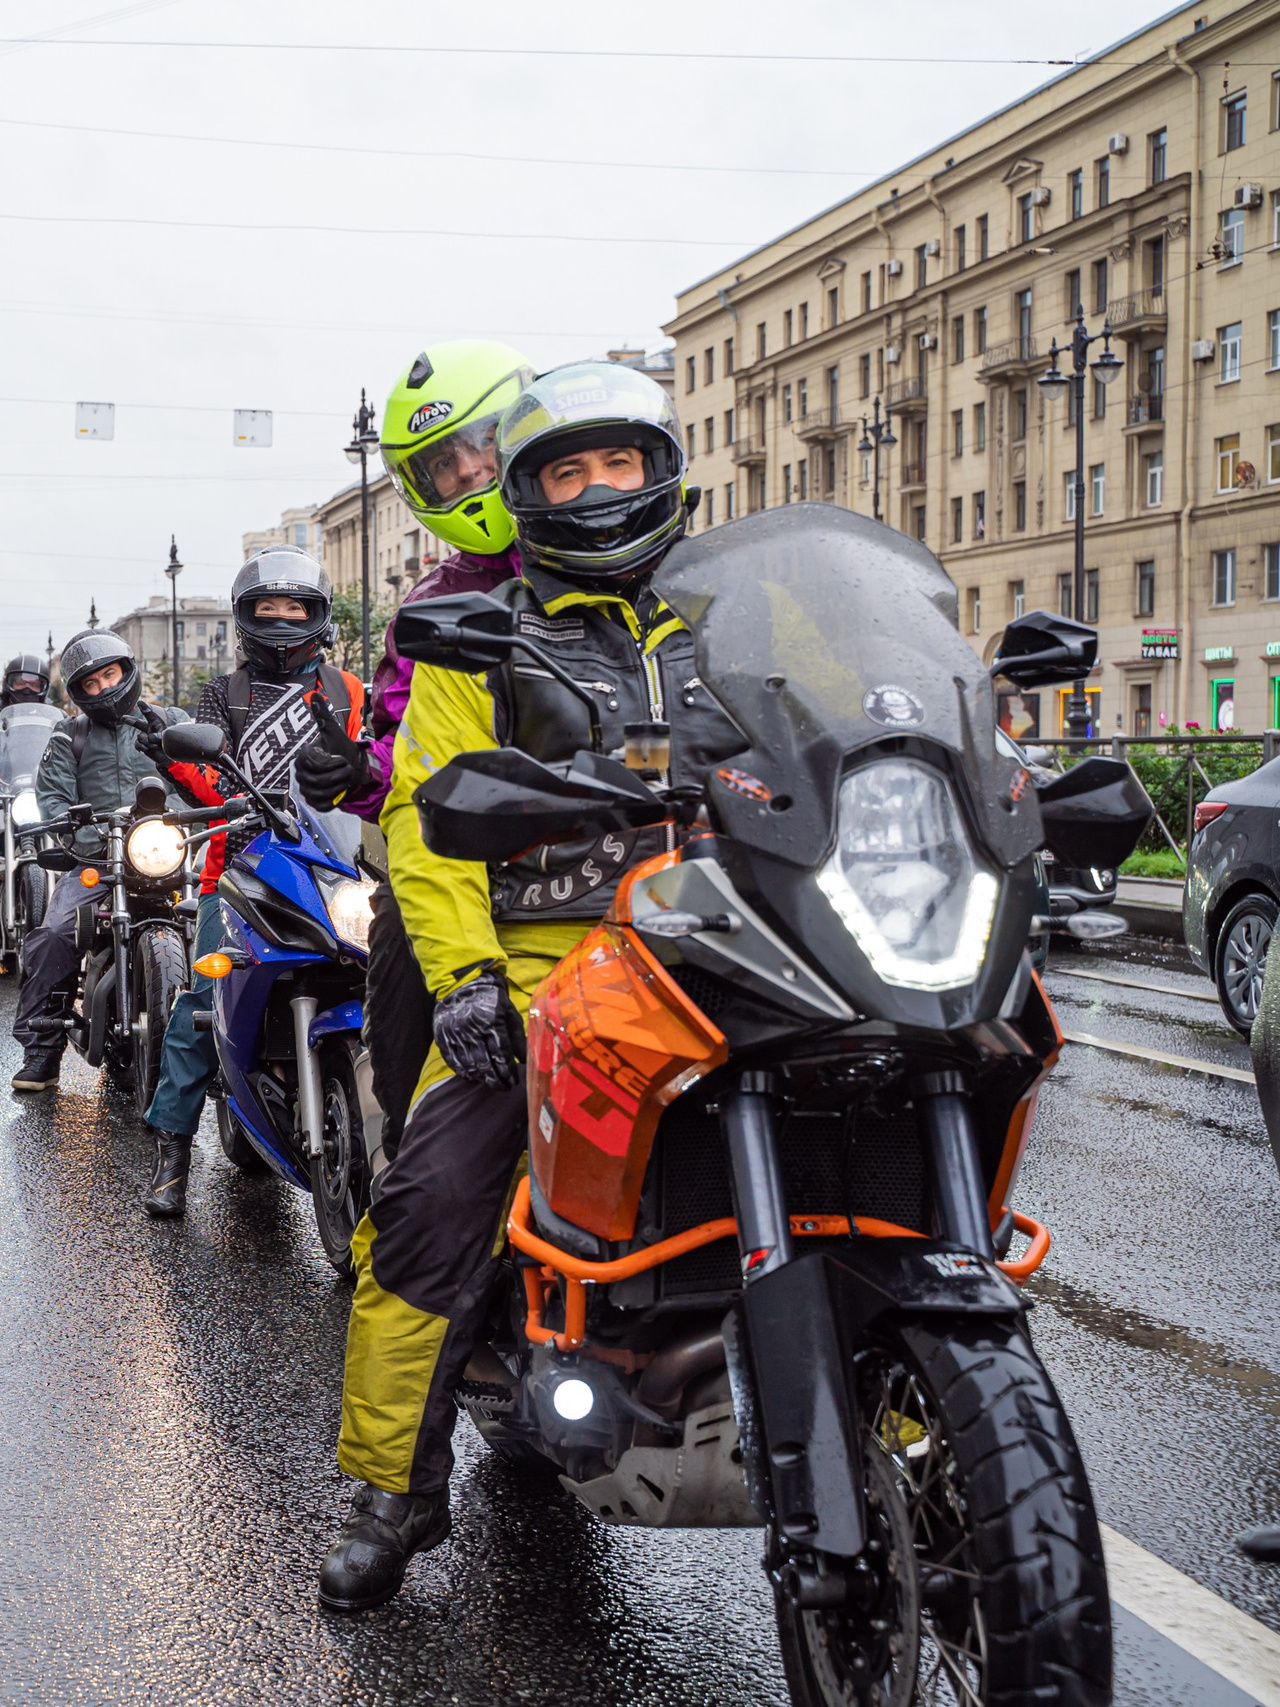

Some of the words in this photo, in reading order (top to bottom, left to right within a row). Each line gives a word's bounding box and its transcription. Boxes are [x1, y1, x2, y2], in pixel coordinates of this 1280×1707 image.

[555, 389, 607, 412] SHOEI
[410, 402, 452, 432] Airoh
[1141, 646, 1178, 658] ТАБАК
